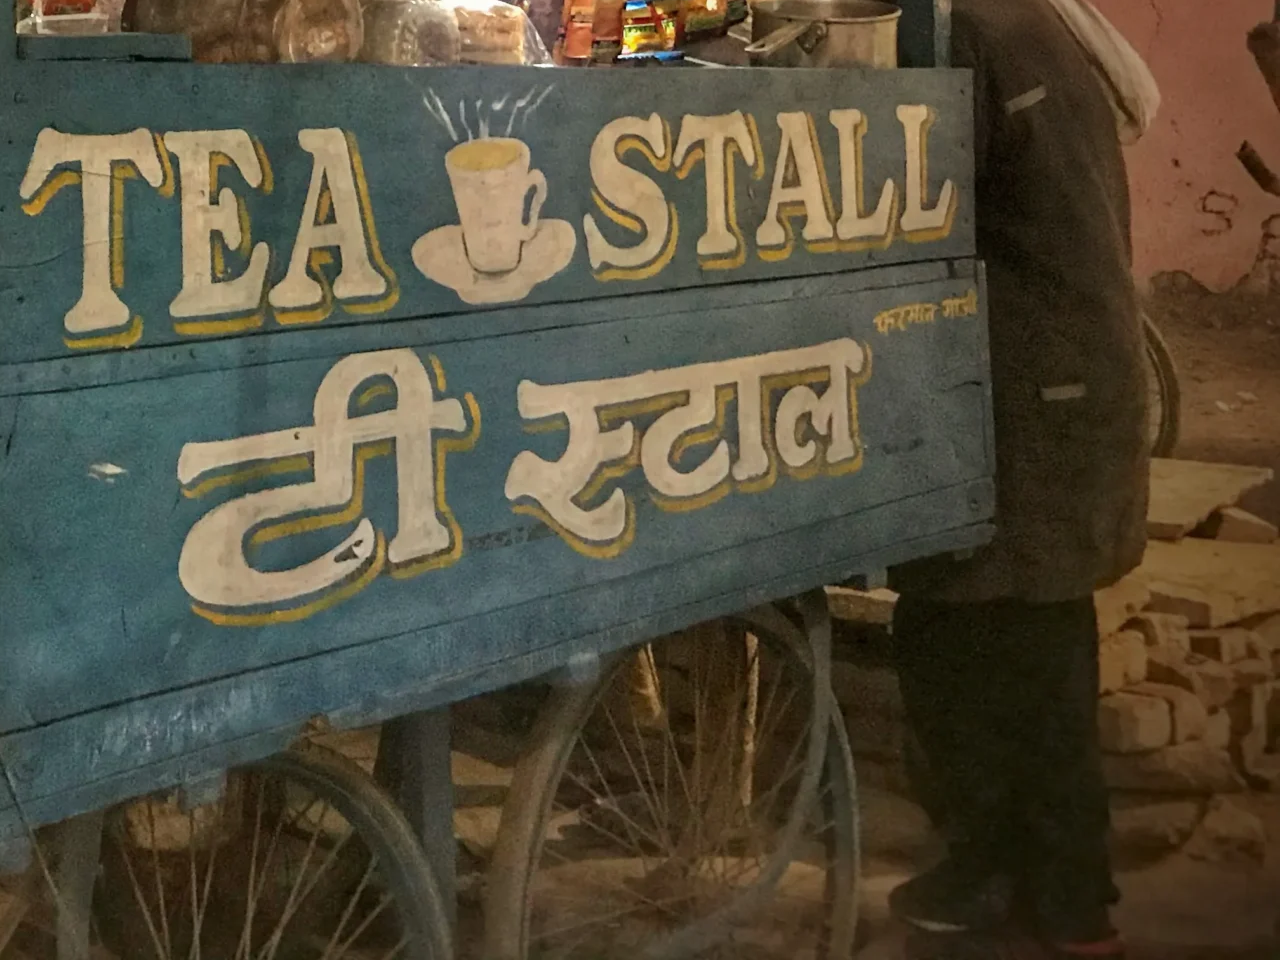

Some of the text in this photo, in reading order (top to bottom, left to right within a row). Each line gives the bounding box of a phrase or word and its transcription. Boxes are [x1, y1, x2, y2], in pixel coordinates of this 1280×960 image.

[19, 103, 958, 349] TEA STALL
[176, 337, 872, 626] टी स्टाल
